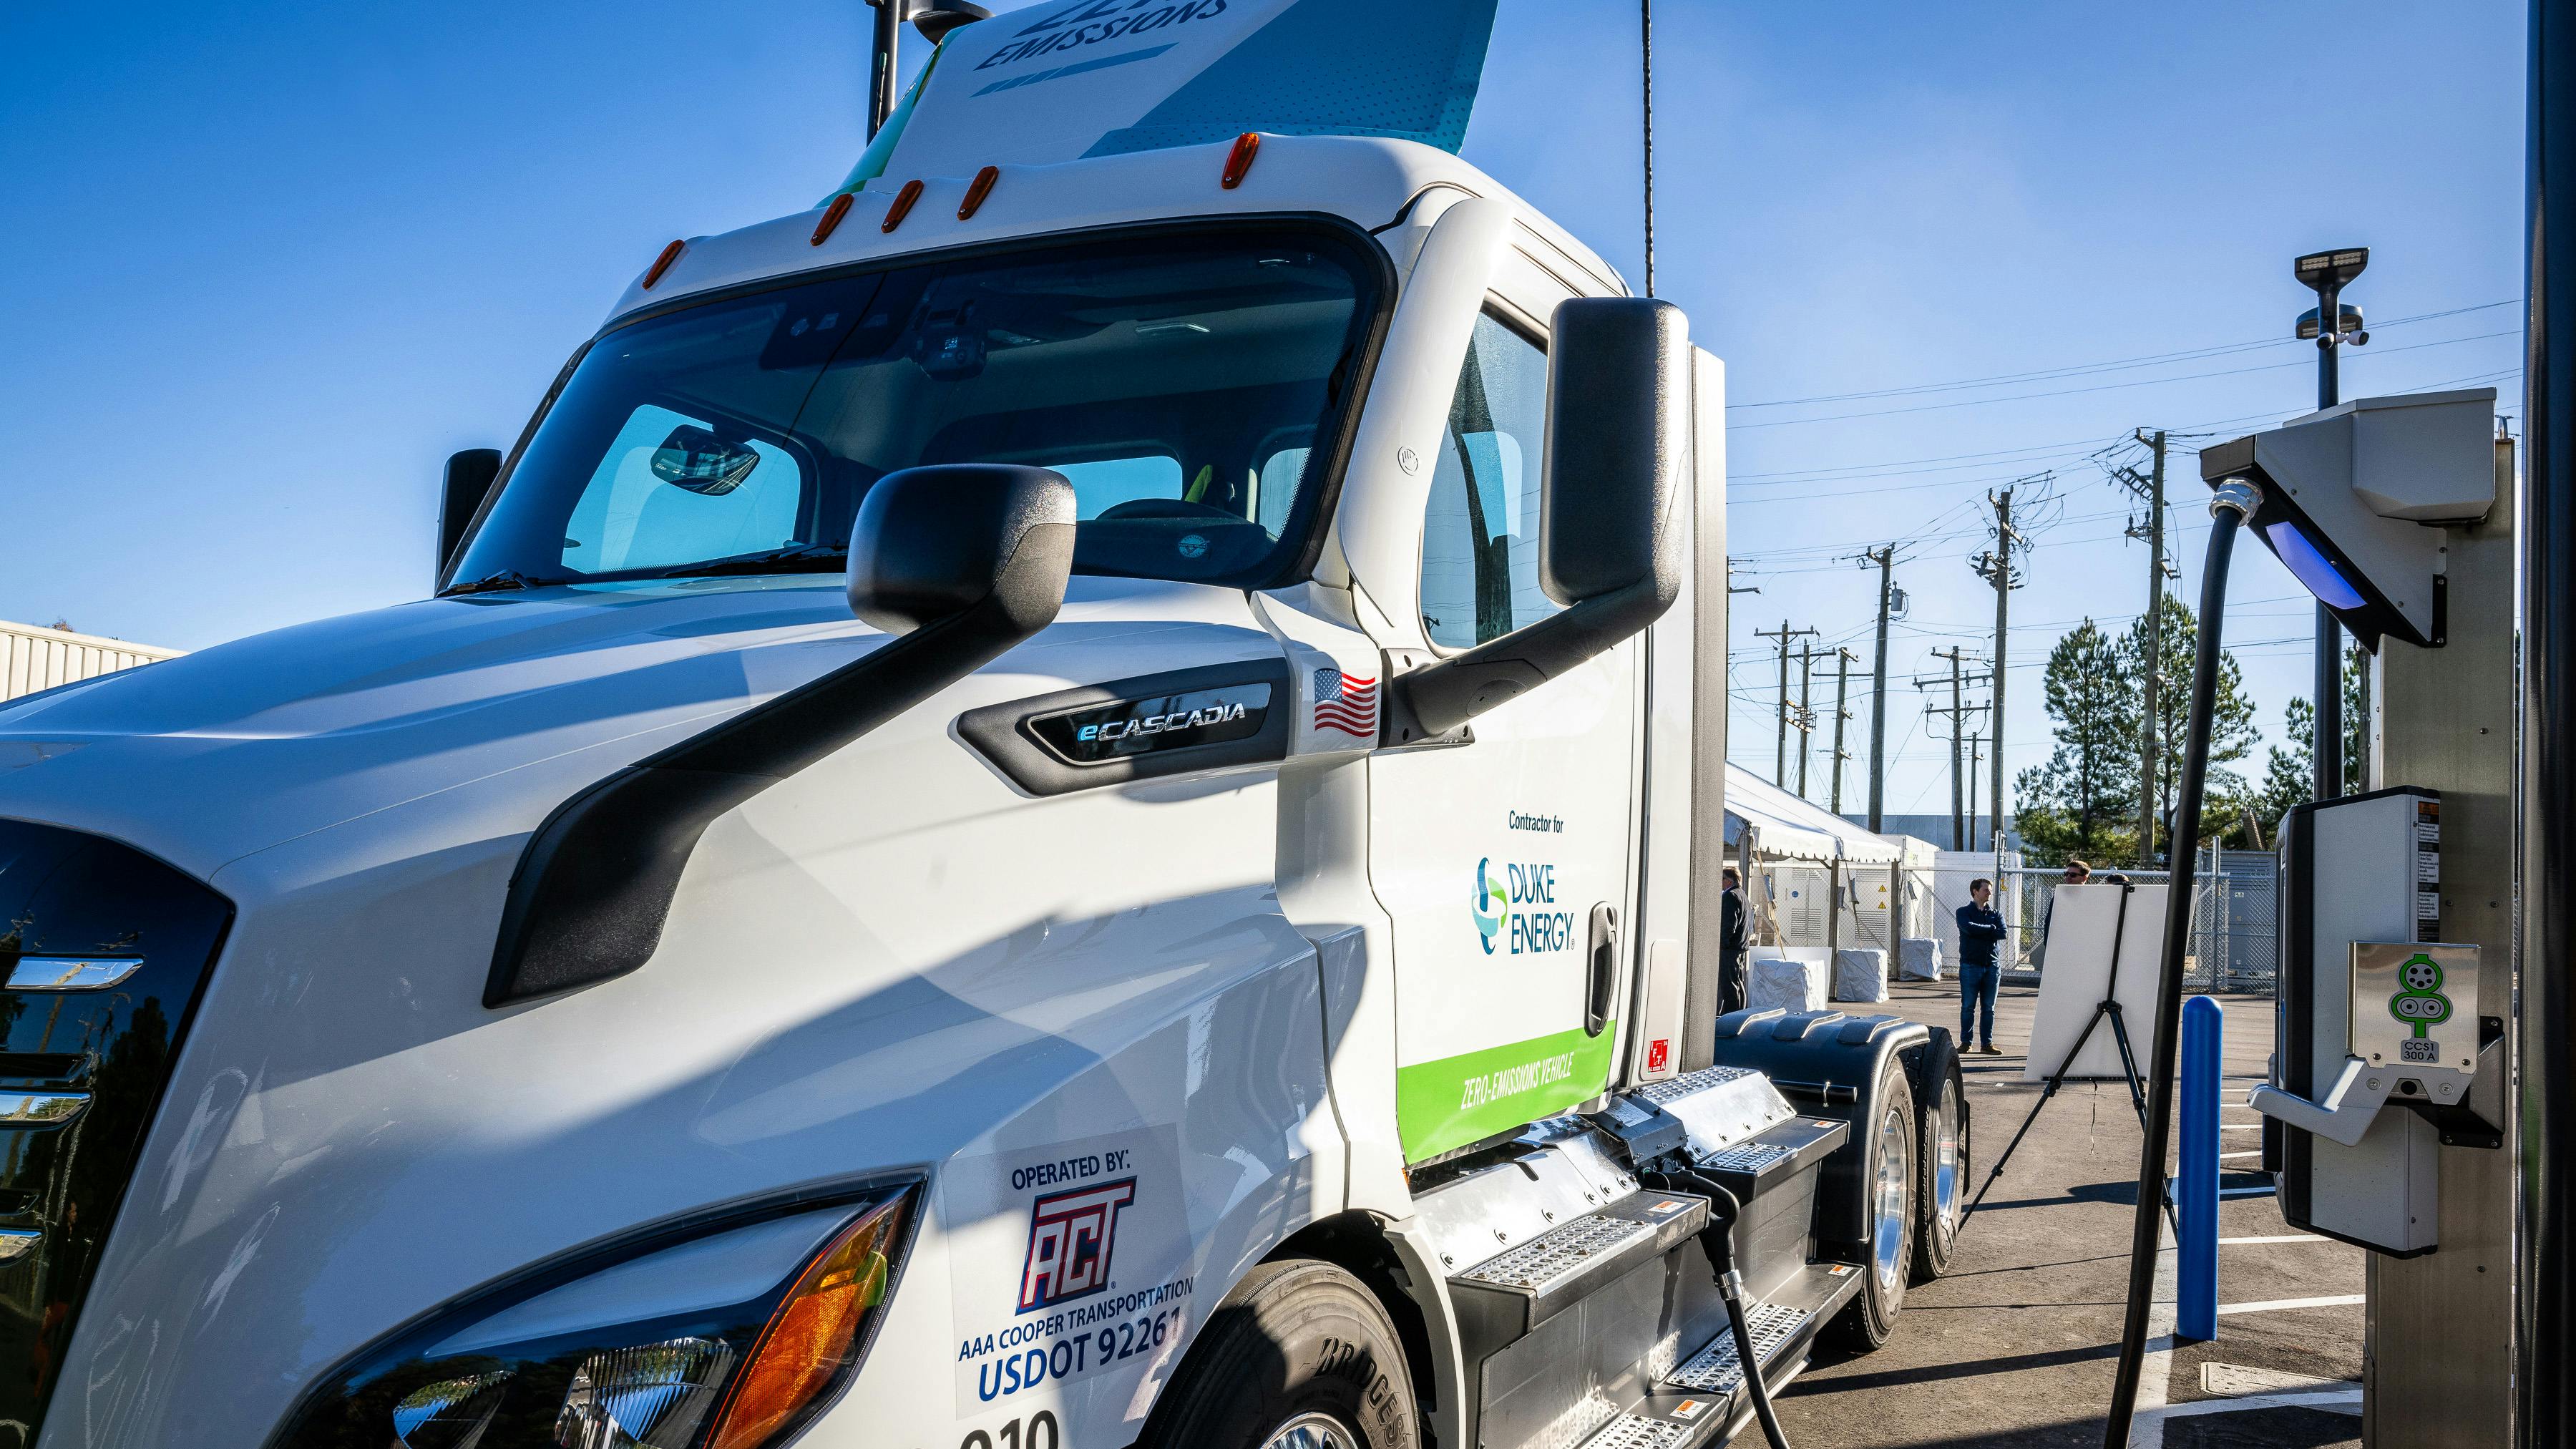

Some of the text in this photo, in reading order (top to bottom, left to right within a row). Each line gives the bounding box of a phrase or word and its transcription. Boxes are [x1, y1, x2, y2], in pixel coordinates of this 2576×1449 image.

[972, 0, 1226, 72] EMISSIONS
[1077, 703, 1246, 743] eCASCADIA
[1509, 809, 1564, 834] Contractor for
[1508, 863, 1555, 904] DUKE
[1511, 912, 1574, 955] ENERGY
[2404, 1041, 2434, 1052] CCS1
[2404, 1050, 2436, 1061] 300 A
[1460, 1051, 1575, 1111] ZERO-EMISSIONS VEHICLE
[1011, 1149, 1131, 1190] OPERATED BY:
[1019, 1181, 1133, 1311] ACT
[958, 1277, 1194, 1362] AAA COOPER TRANSPORTATION
[978, 1306, 1181, 1402] USDOT 92261
